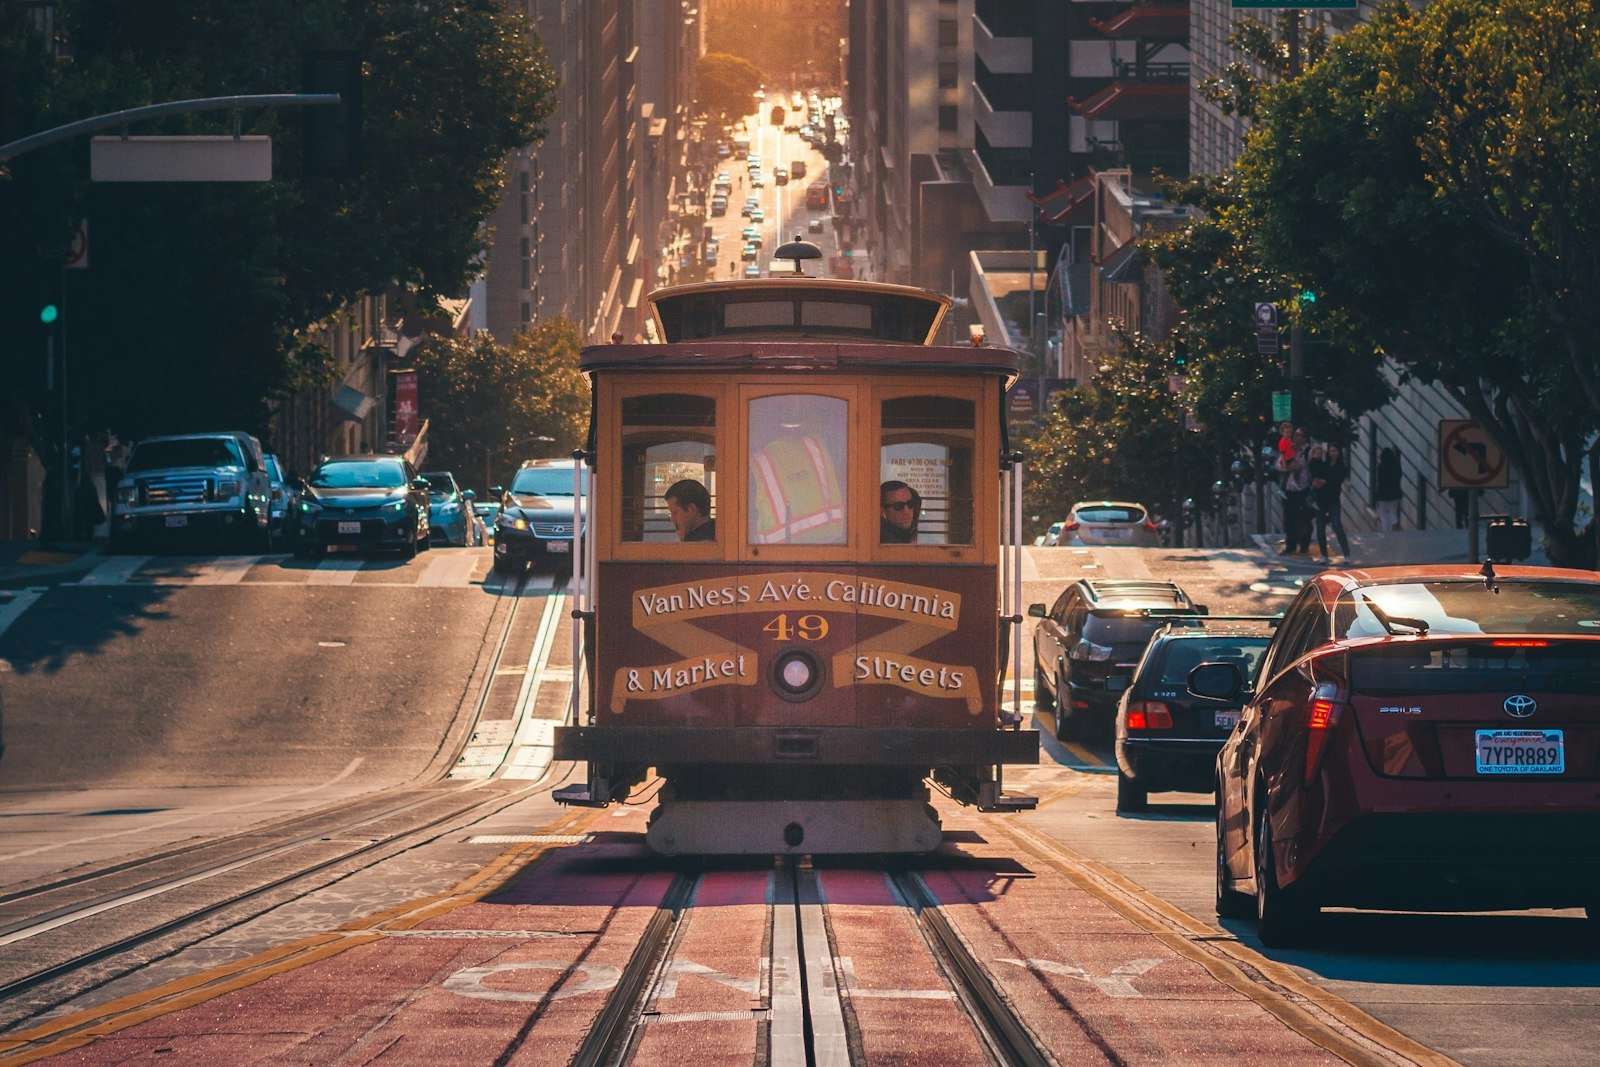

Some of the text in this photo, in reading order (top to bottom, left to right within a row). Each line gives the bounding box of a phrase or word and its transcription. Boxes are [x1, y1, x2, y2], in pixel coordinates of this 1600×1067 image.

[924, 458, 938, 466] ONE
[638, 592, 684, 616] Van
[687, 585, 751, 609] Ness
[826, 580, 955, 619] California
[762, 613, 829, 641] 49
[627, 655, 746, 692] & Market
[854, 656, 964, 691] Streets
[1482, 746, 1557, 765] 7YPR889
[1494, 737, 1546, 746] California
